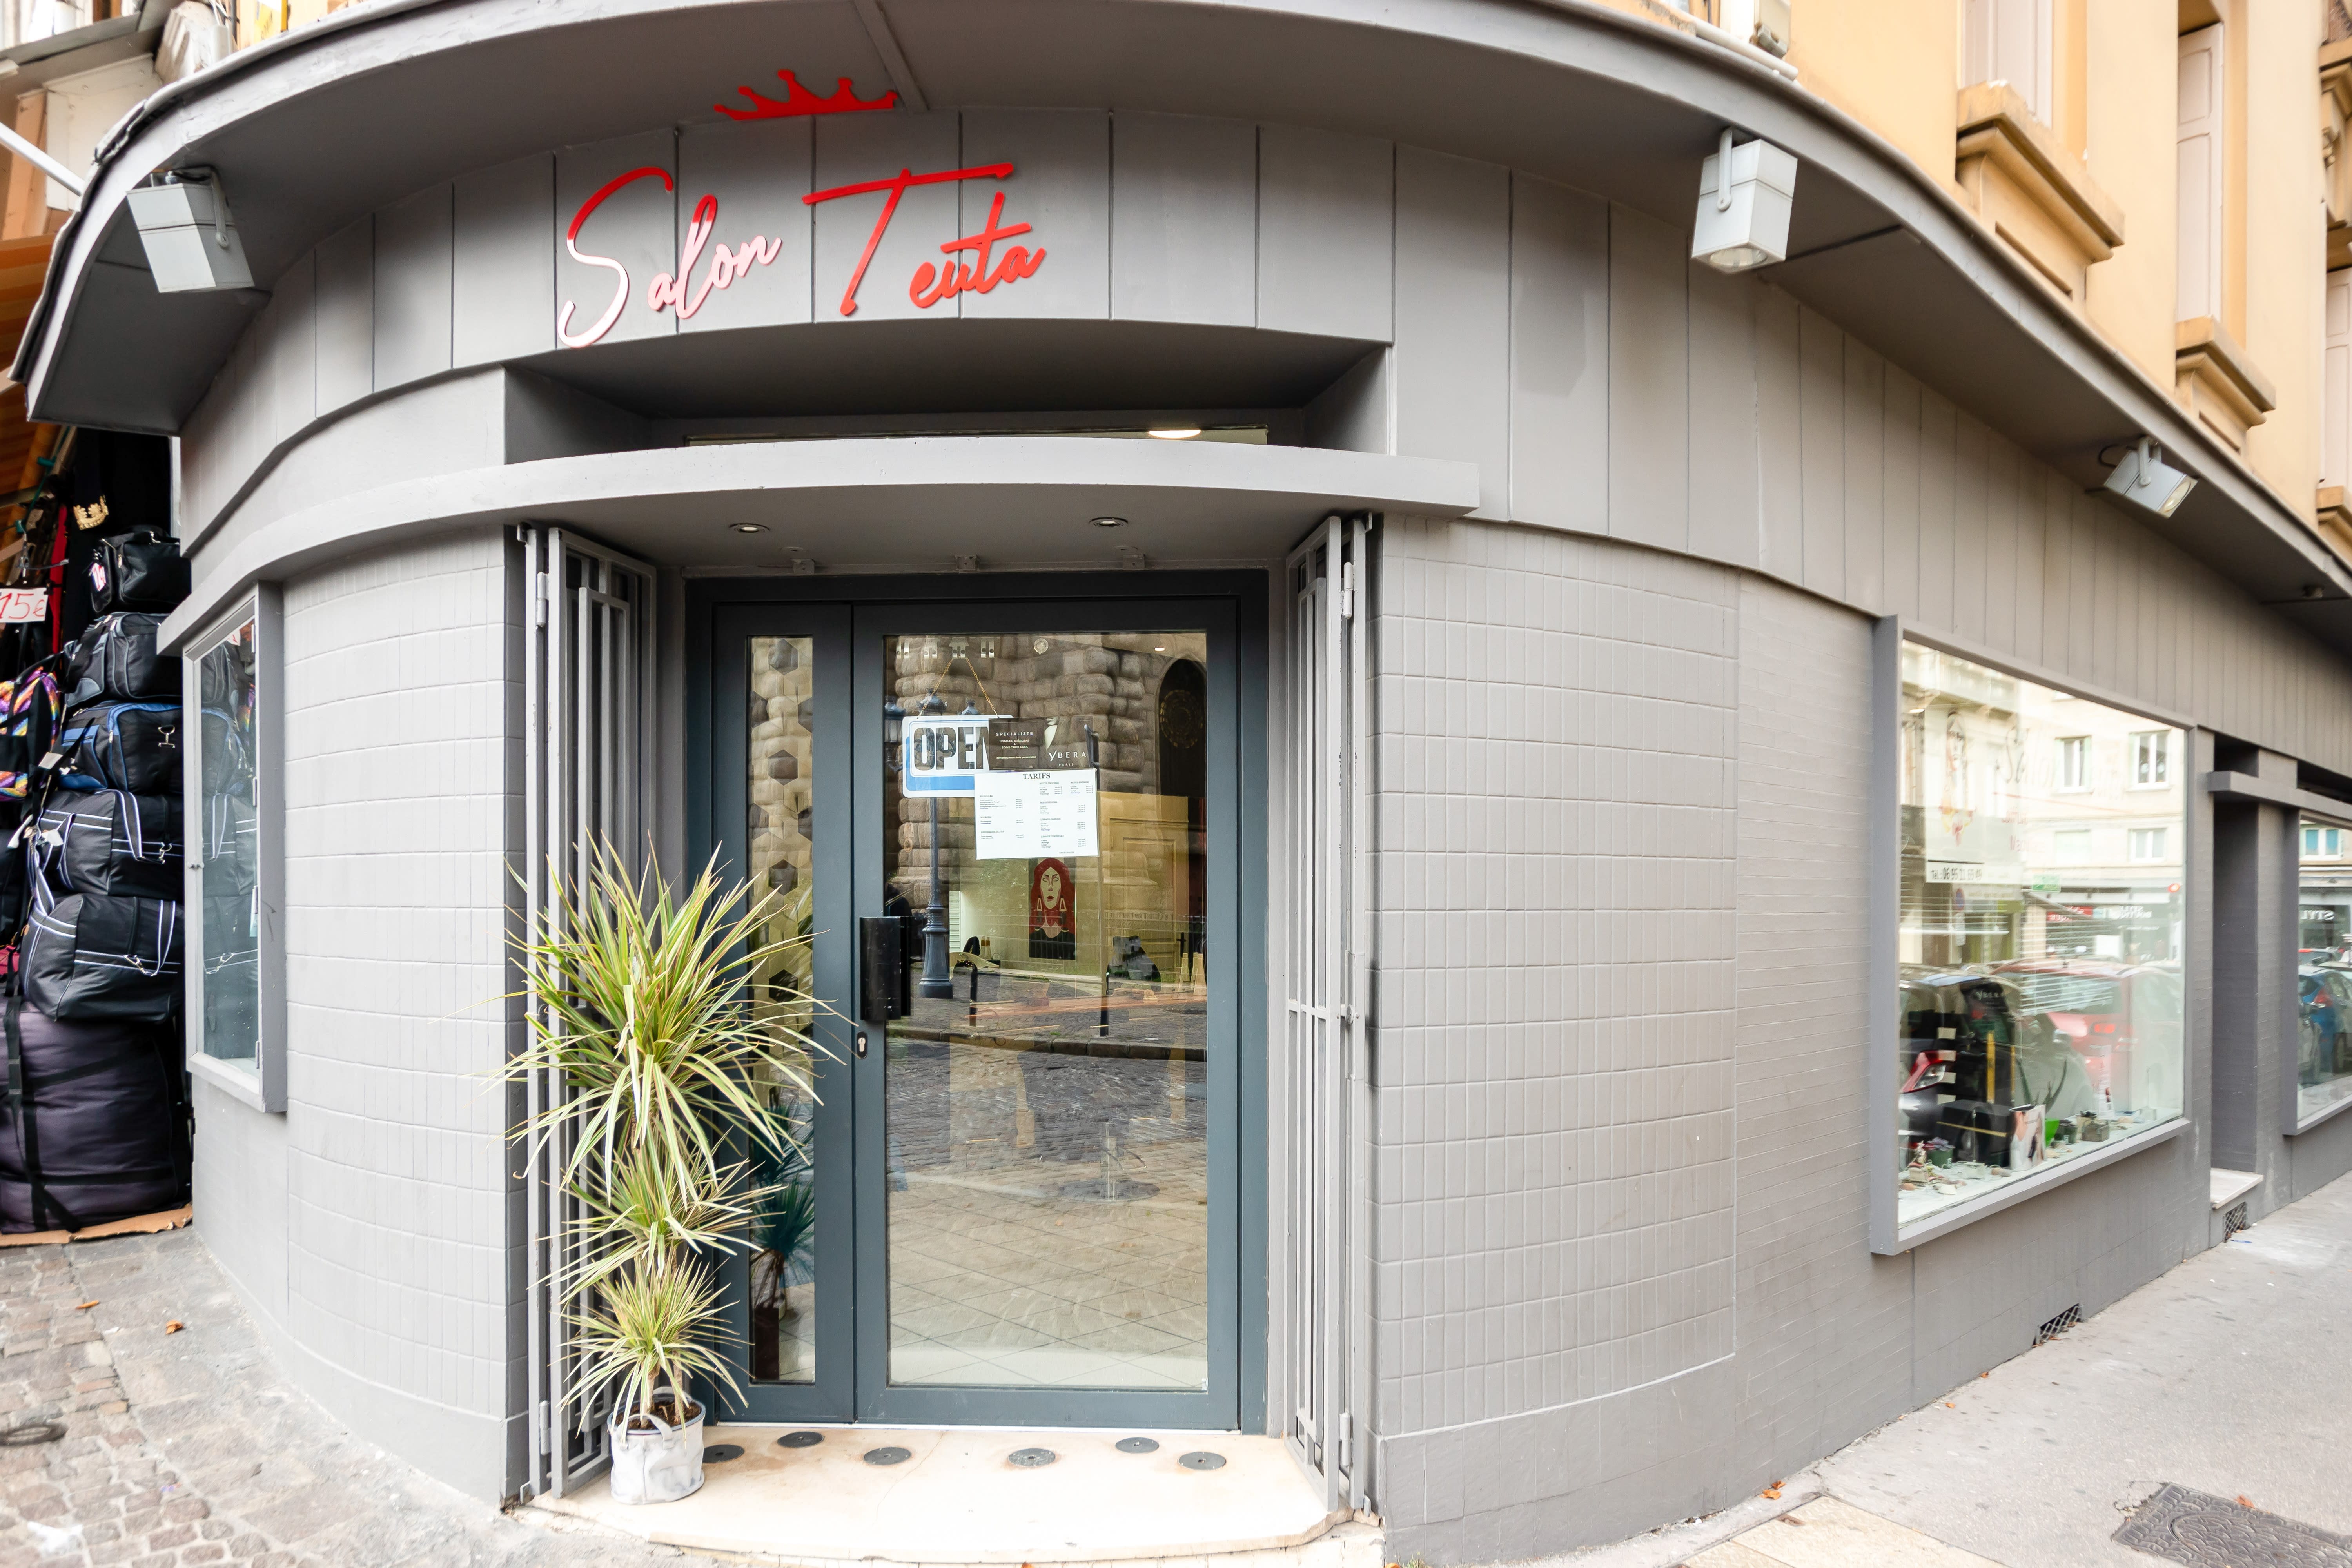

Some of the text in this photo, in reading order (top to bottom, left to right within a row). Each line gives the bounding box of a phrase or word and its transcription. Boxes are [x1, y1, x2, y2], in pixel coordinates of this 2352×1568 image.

[558, 163, 1047, 348] Salon Teuta
[0, 592, 44, 619] 15€
